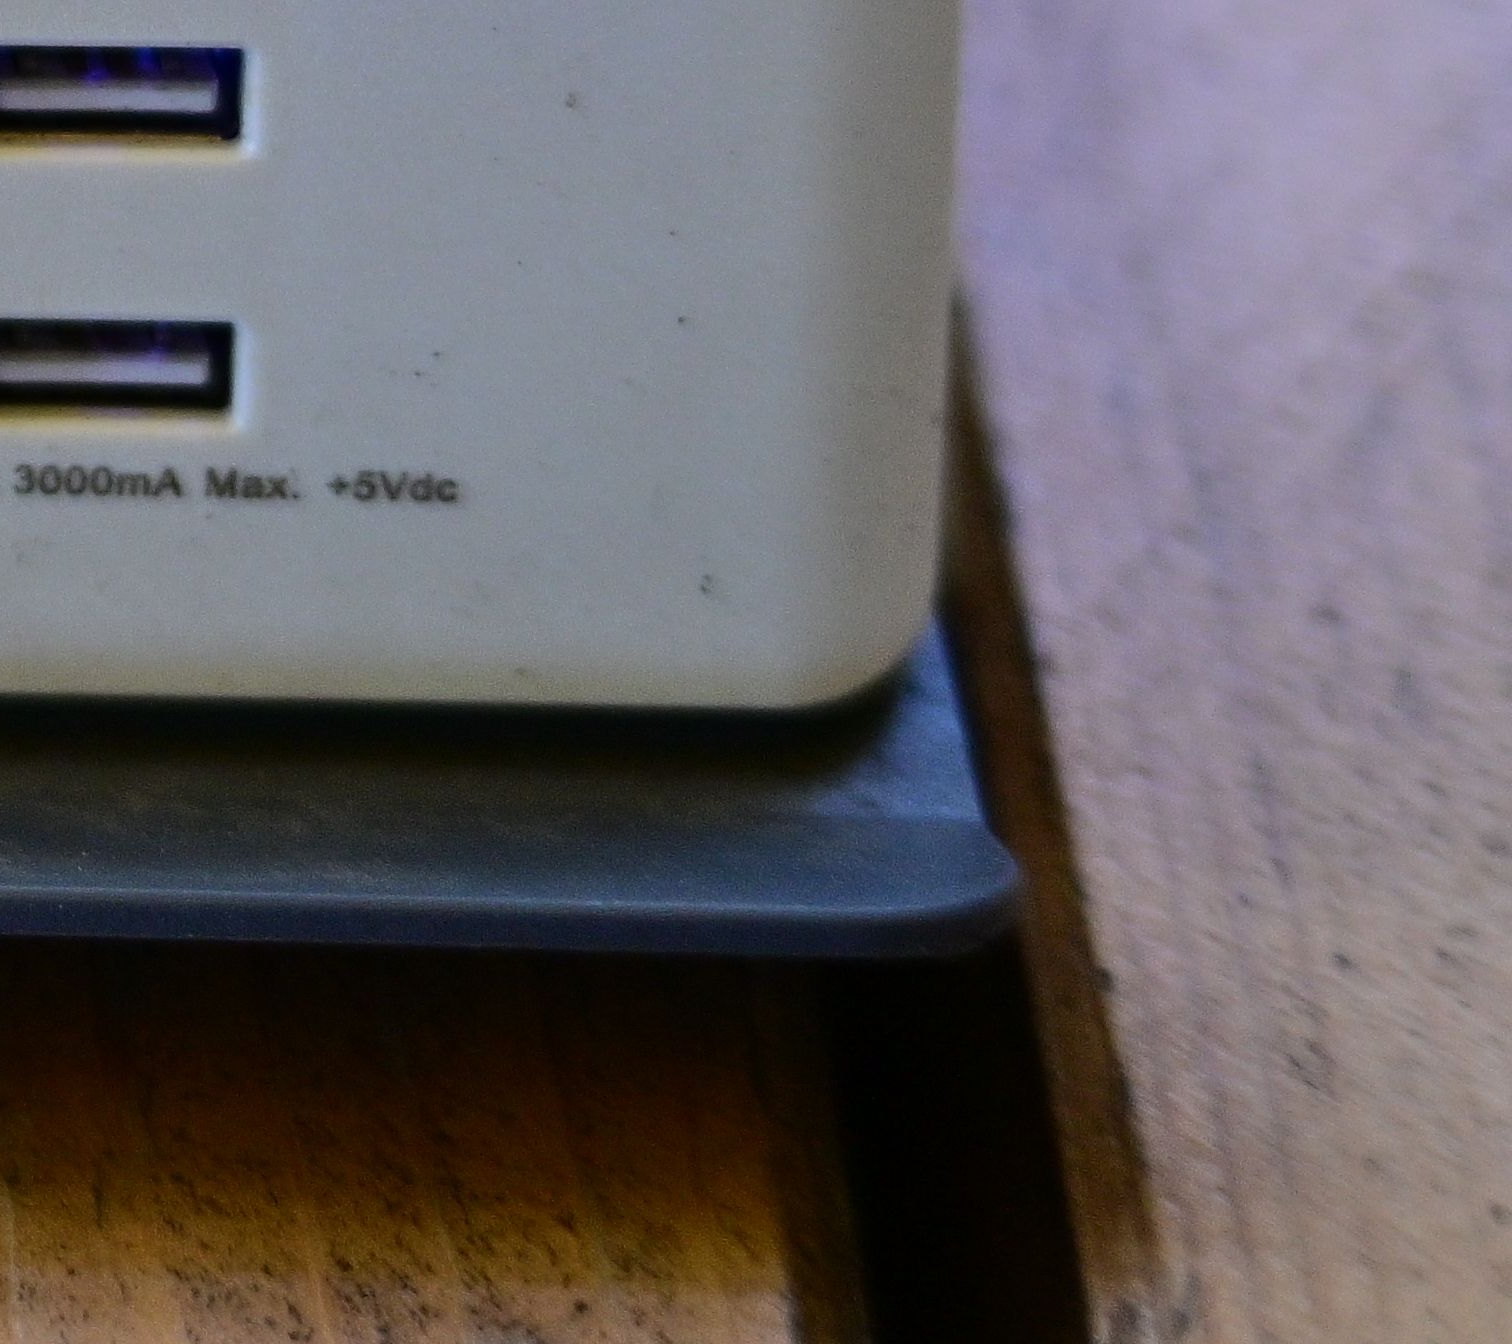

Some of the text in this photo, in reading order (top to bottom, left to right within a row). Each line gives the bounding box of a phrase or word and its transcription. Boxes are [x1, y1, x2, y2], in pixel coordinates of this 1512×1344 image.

[14, 464, 183, 498] 3000mA
[205, 467, 298, 501] Max.
[327, 469, 459, 503] +5Vdc
